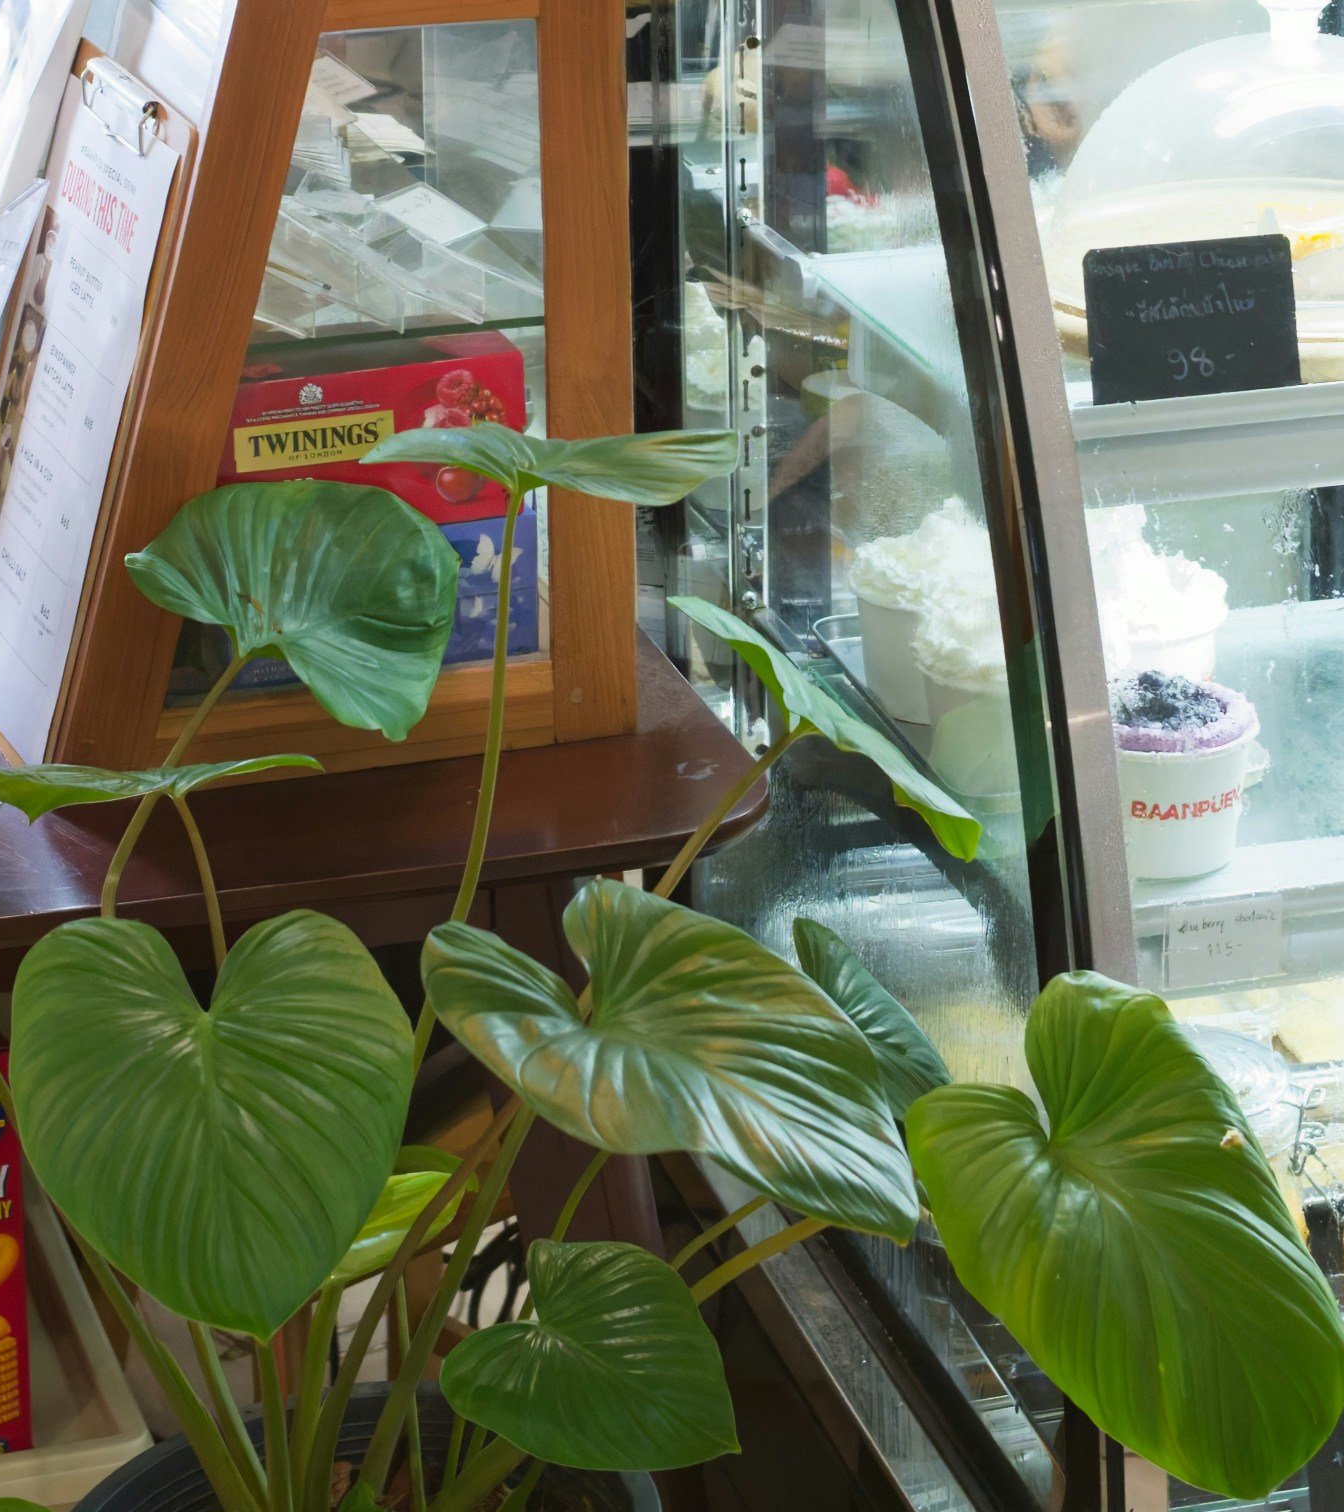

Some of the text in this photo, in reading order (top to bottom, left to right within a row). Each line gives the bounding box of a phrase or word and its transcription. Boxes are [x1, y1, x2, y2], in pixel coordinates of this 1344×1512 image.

[102, 163, 124, 187] SPECIAL
[61, 159, 139, 255] DURING THIS TIME
[69, 255, 103, 294] PEANUT BUTTER
[69, 279, 95, 310] ICED LATTE
[59, 376, 76, 400] LATTE
[248, 420, 379, 458] TWININGS
